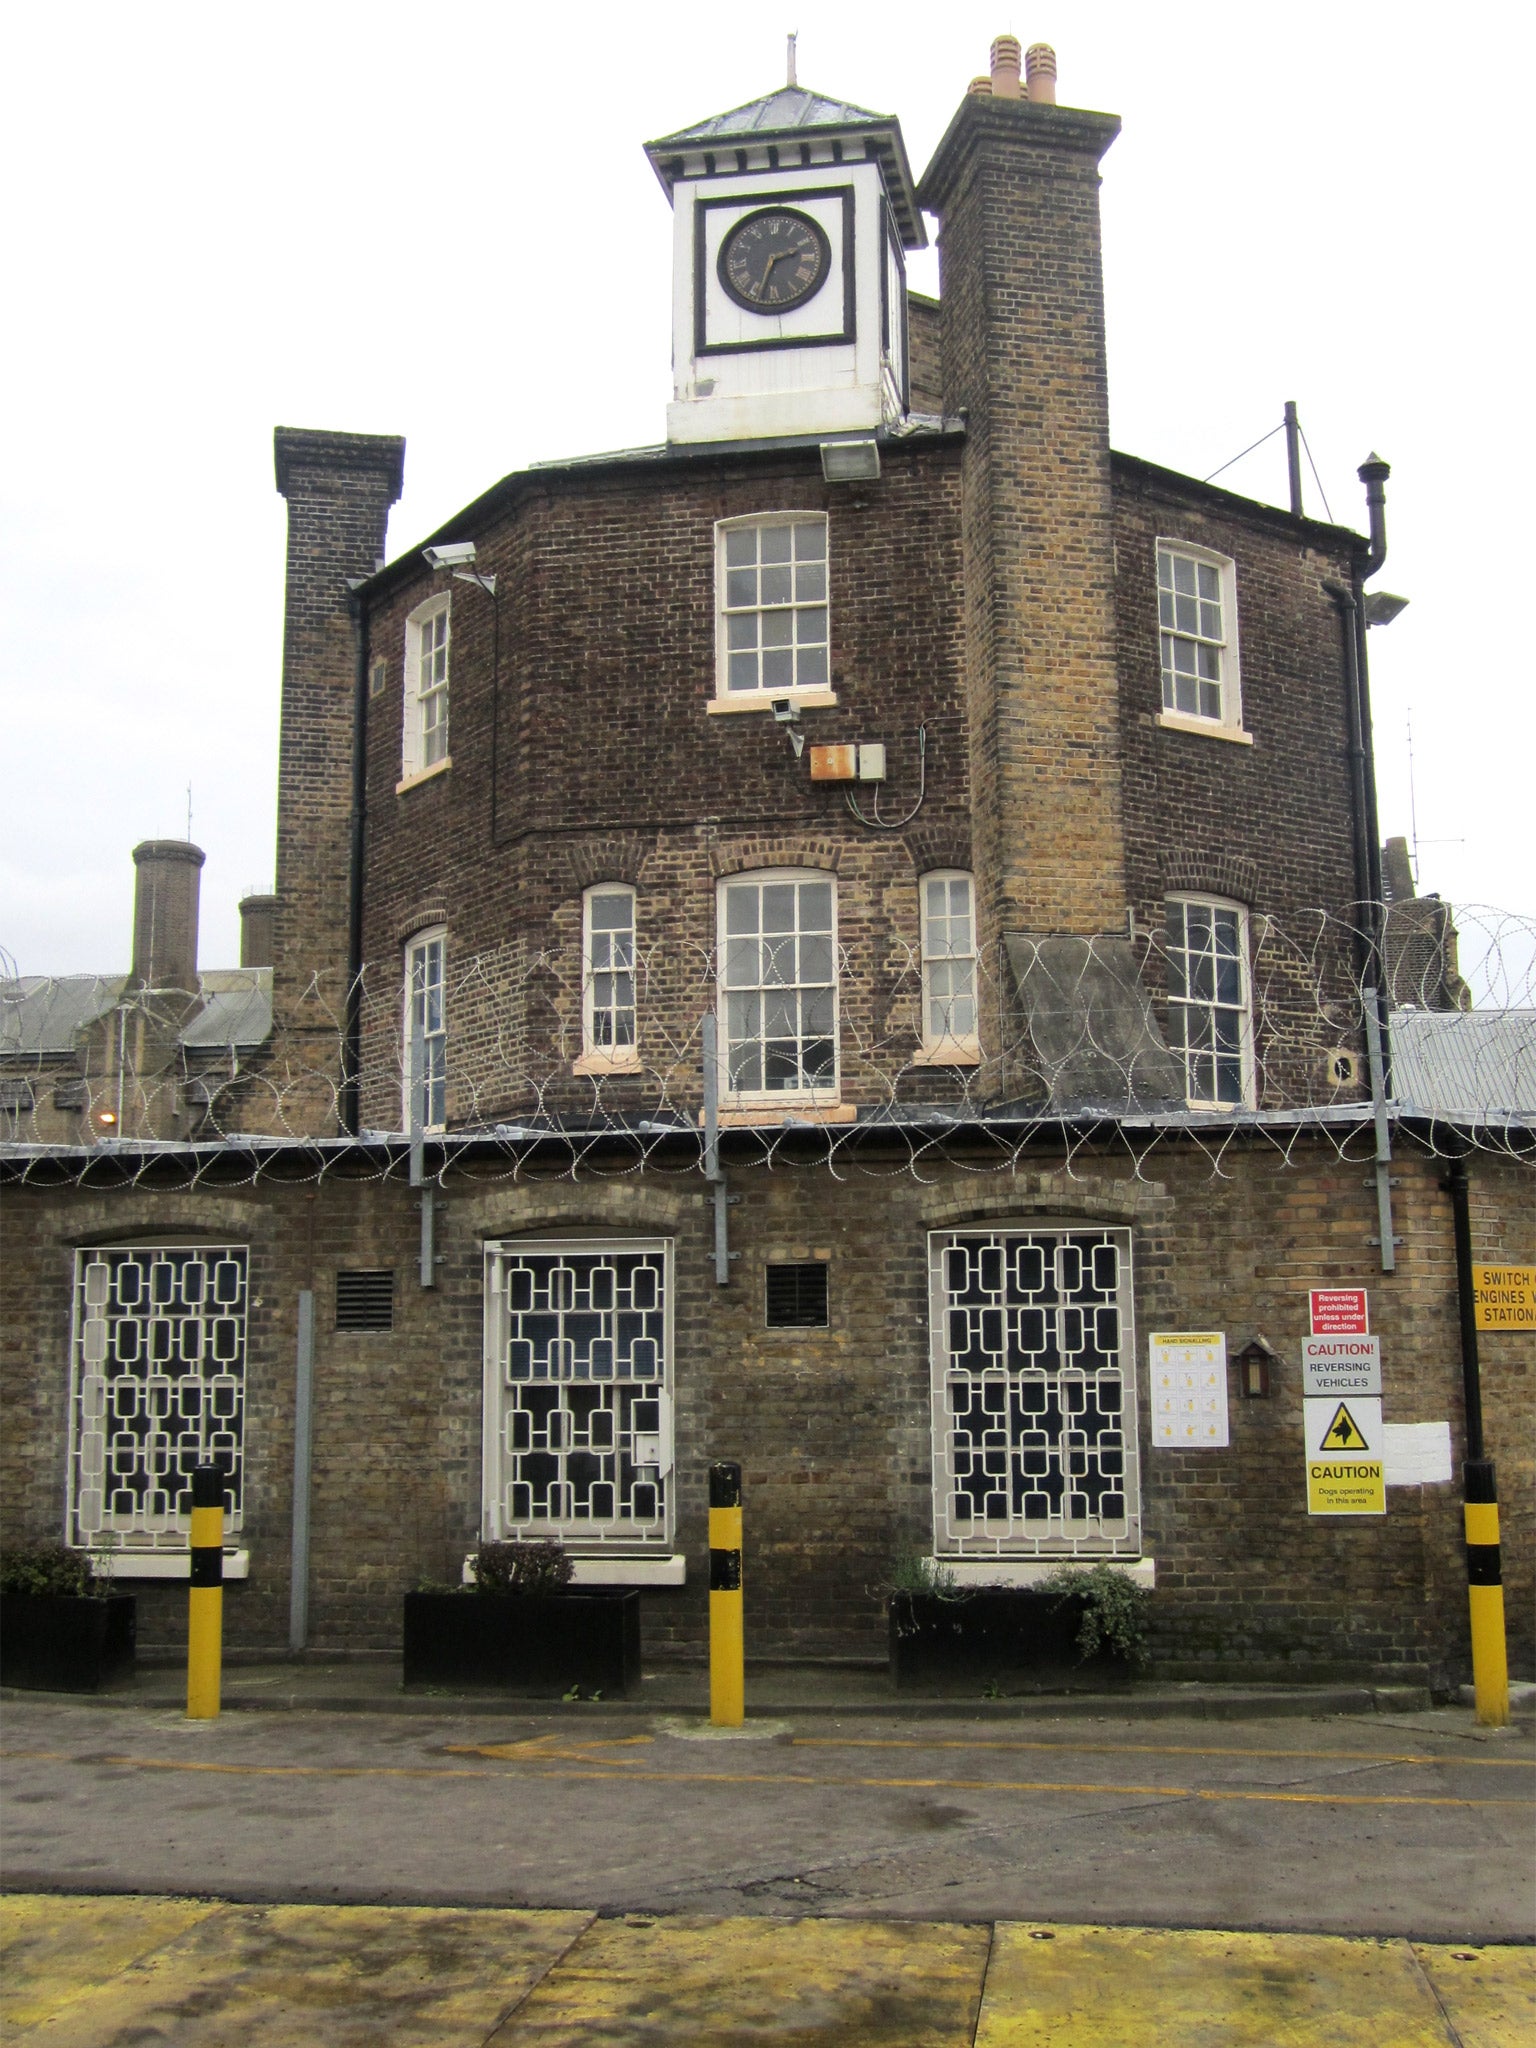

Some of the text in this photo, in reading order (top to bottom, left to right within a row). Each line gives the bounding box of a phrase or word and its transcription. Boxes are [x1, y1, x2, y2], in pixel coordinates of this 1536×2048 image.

[1483, 1271, 1530, 1285] SWITCH
[1318, 1294, 1358, 1303] Reversing
[1474, 1290, 1525, 1304] ENGINES
[1318, 1304, 1359, 1313] prohibited
[1313, 1313, 1340, 1321] unless
[1484, 1308, 1536, 1322] STATION
[1307, 1343, 1374, 1356] CAUTION!
[1310, 1362, 1371, 1372] REVERSING
[1316, 1378, 1368, 1387] VEHICLES
[1311, 1466, 1380, 1479] CAUTION
[1318, 1488, 1374, 1496] Dogs operating
